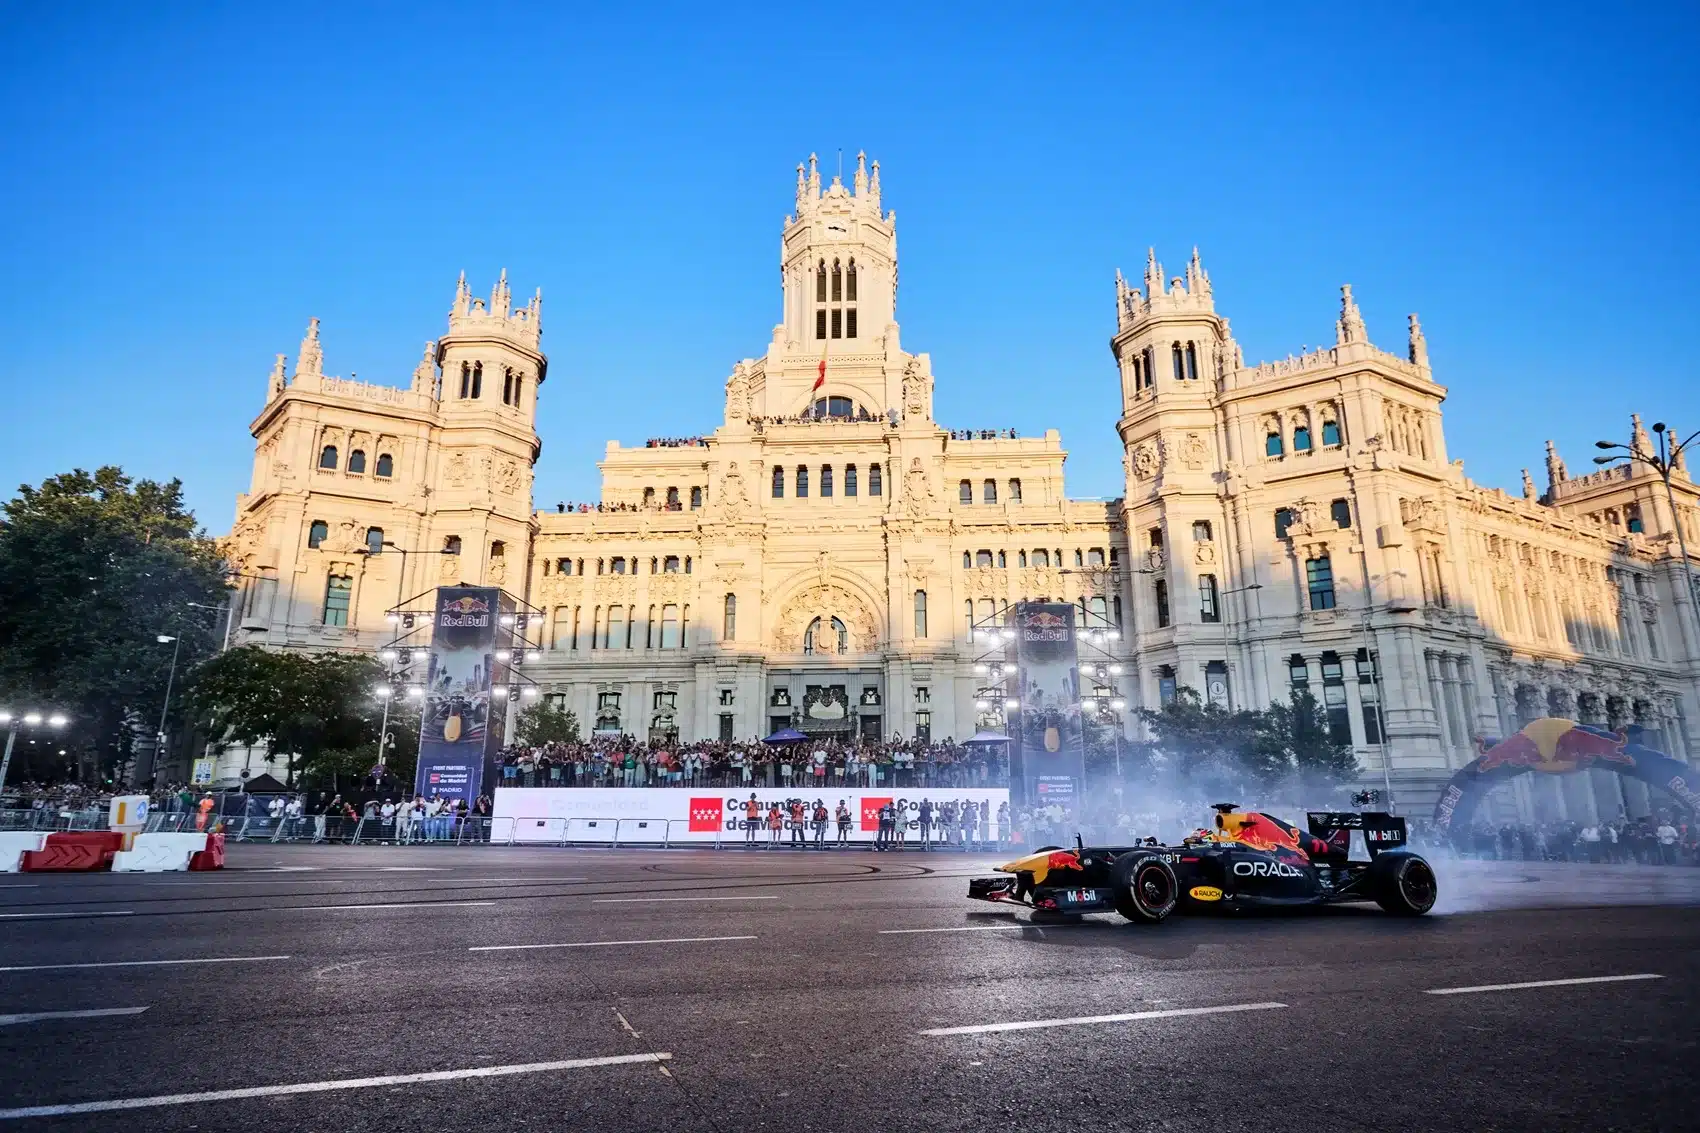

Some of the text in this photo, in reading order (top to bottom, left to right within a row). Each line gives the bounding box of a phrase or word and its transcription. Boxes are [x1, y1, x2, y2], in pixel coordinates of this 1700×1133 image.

[440, 614, 489, 627] Red Bull
[1024, 629, 1068, 641] Red Bull
[1368, 830, 1392, 841] Mobil
[1067, 888, 1096, 902] Mobil
[1198, 889, 1221, 898] RAUCH
